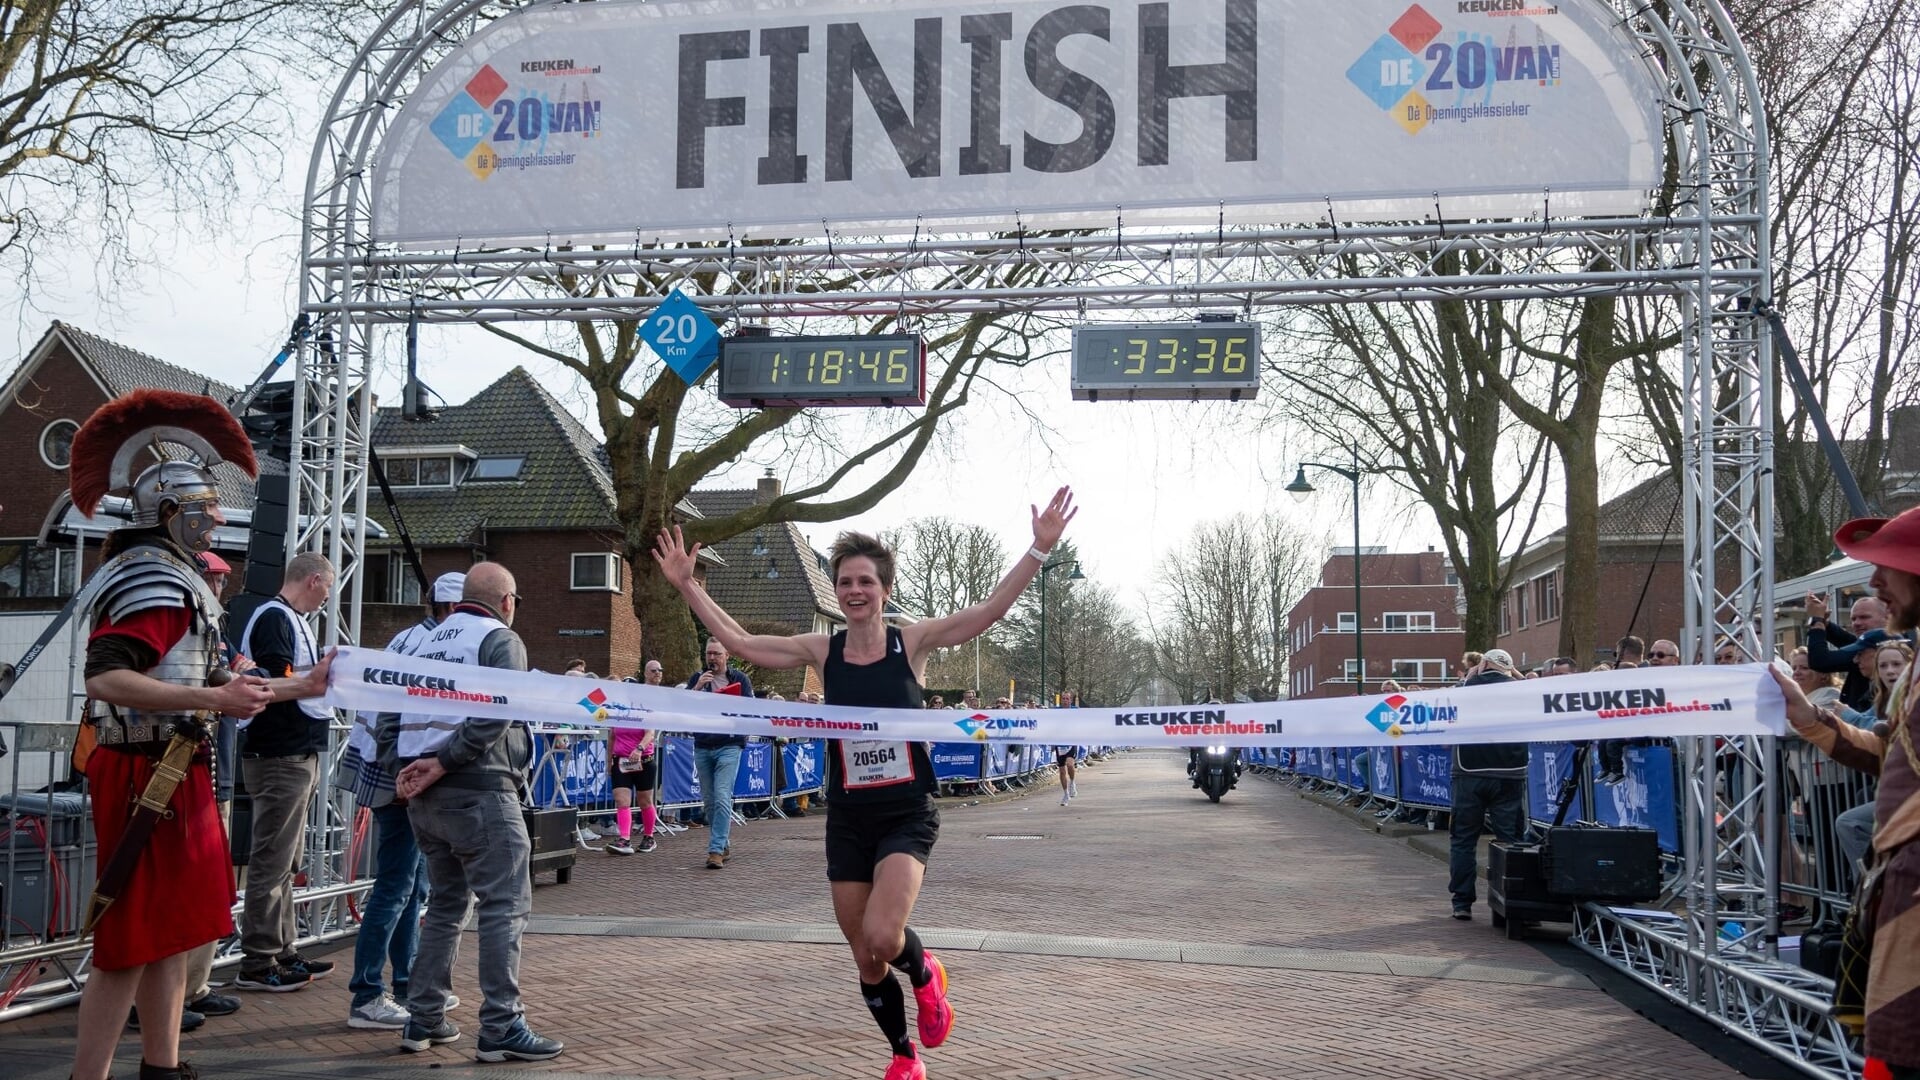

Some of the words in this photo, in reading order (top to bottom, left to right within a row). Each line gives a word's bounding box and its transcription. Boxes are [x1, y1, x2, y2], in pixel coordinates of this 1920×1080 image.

[1458, 0, 1525, 13] KEUKEN
[521, 59, 575, 73] KEUKEN
[1380, 58, 1414, 87] DE
[676, 0, 1257, 189] FINISH
[1425, 101, 1531, 124] Openingsklassieker
[457, 113, 483, 138] DE
[492, 151, 576, 171] Openingsklassieker
[656, 314, 697, 344] 20
[667, 345, 687, 356] Km
[771, 349, 909, 384] 1:18:46
[431, 628, 464, 643] JURY
[363, 667, 457, 691] KEUKEN
[1543, 688, 1666, 713] KEUKEN
[1115, 710, 1226, 726] KEUKEN
[1380, 711, 1395, 723] DE
[853, 747, 897, 767] 20564
